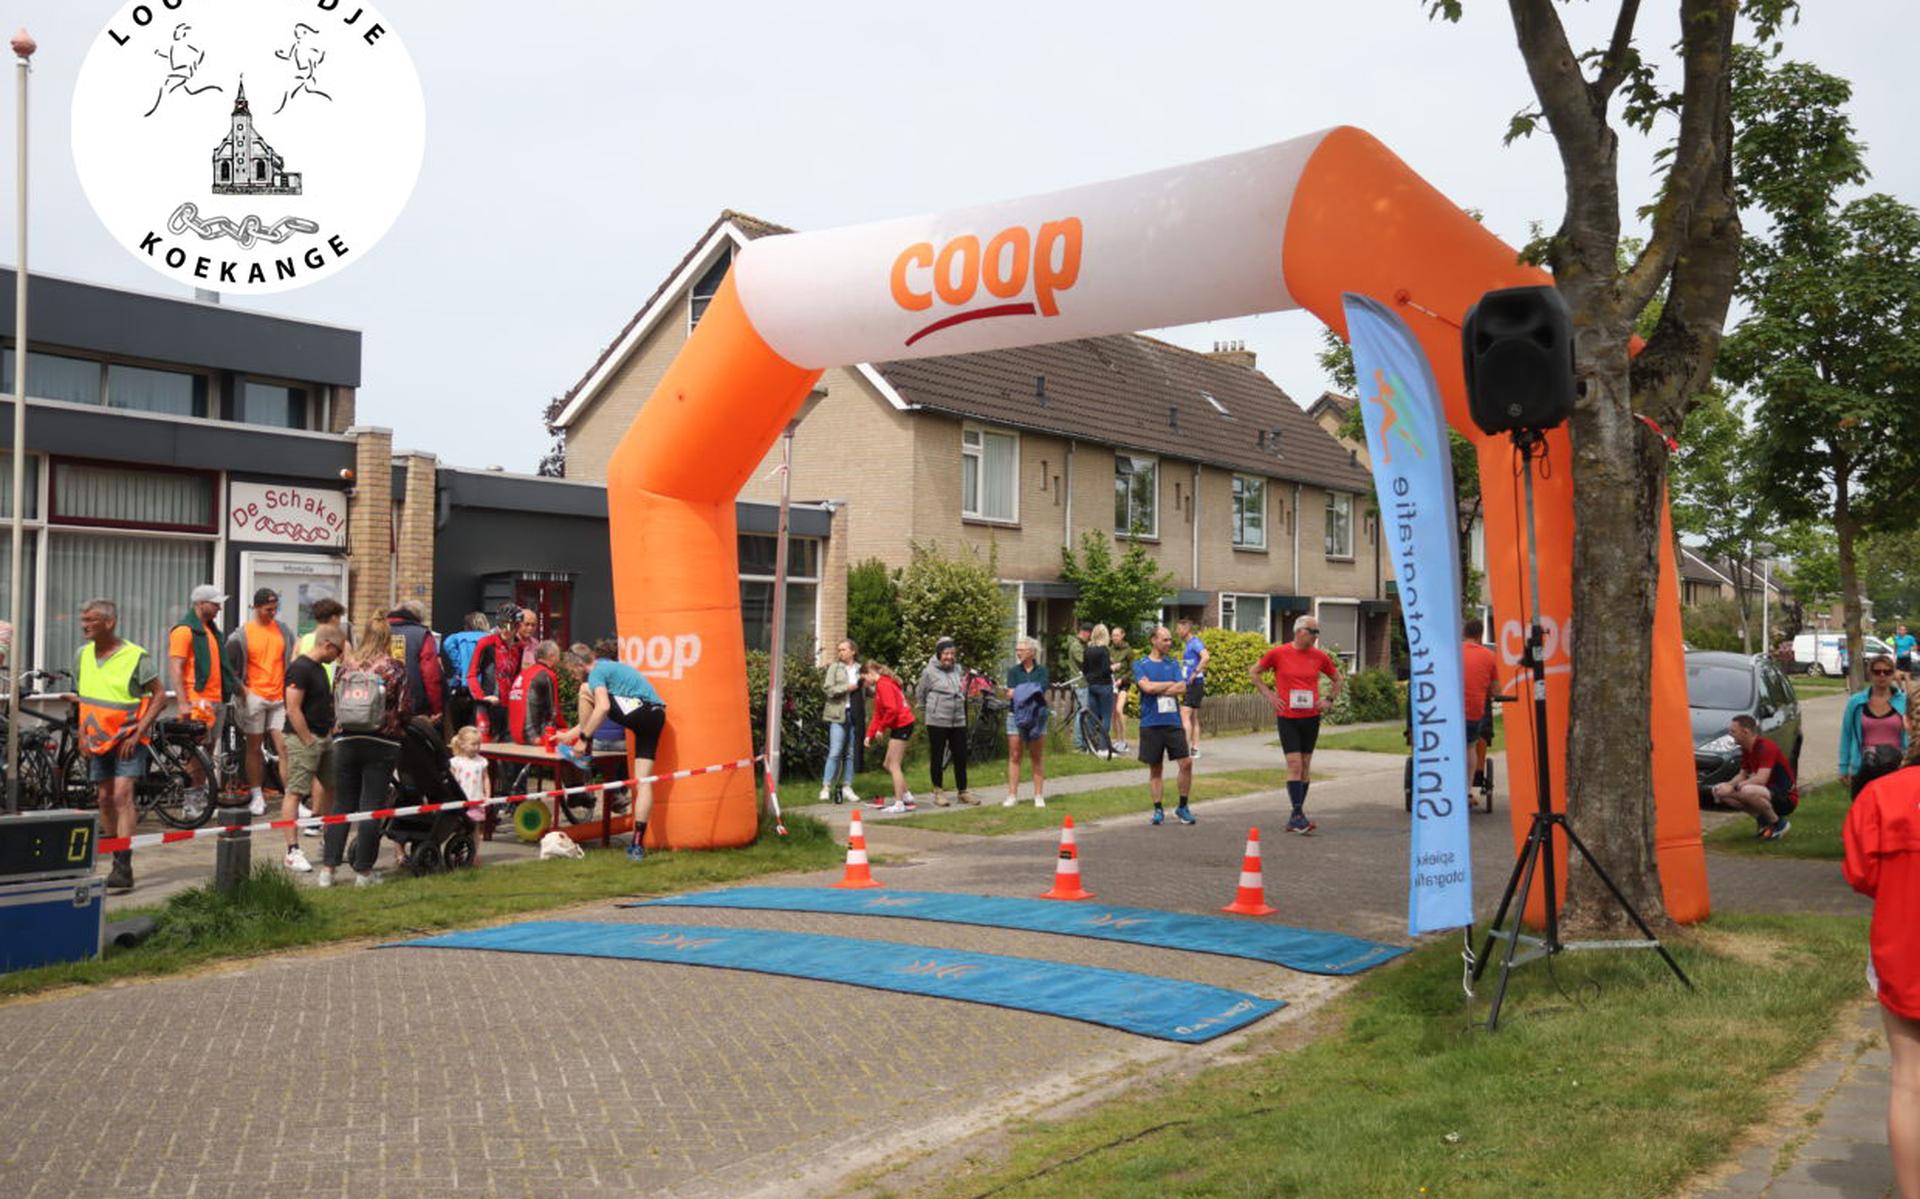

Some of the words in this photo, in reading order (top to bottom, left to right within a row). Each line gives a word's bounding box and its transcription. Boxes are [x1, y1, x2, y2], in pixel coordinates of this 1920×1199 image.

[889, 216, 1084, 318] coop
[232, 502, 259, 528] De
[264, 489, 345, 533] Schakel
